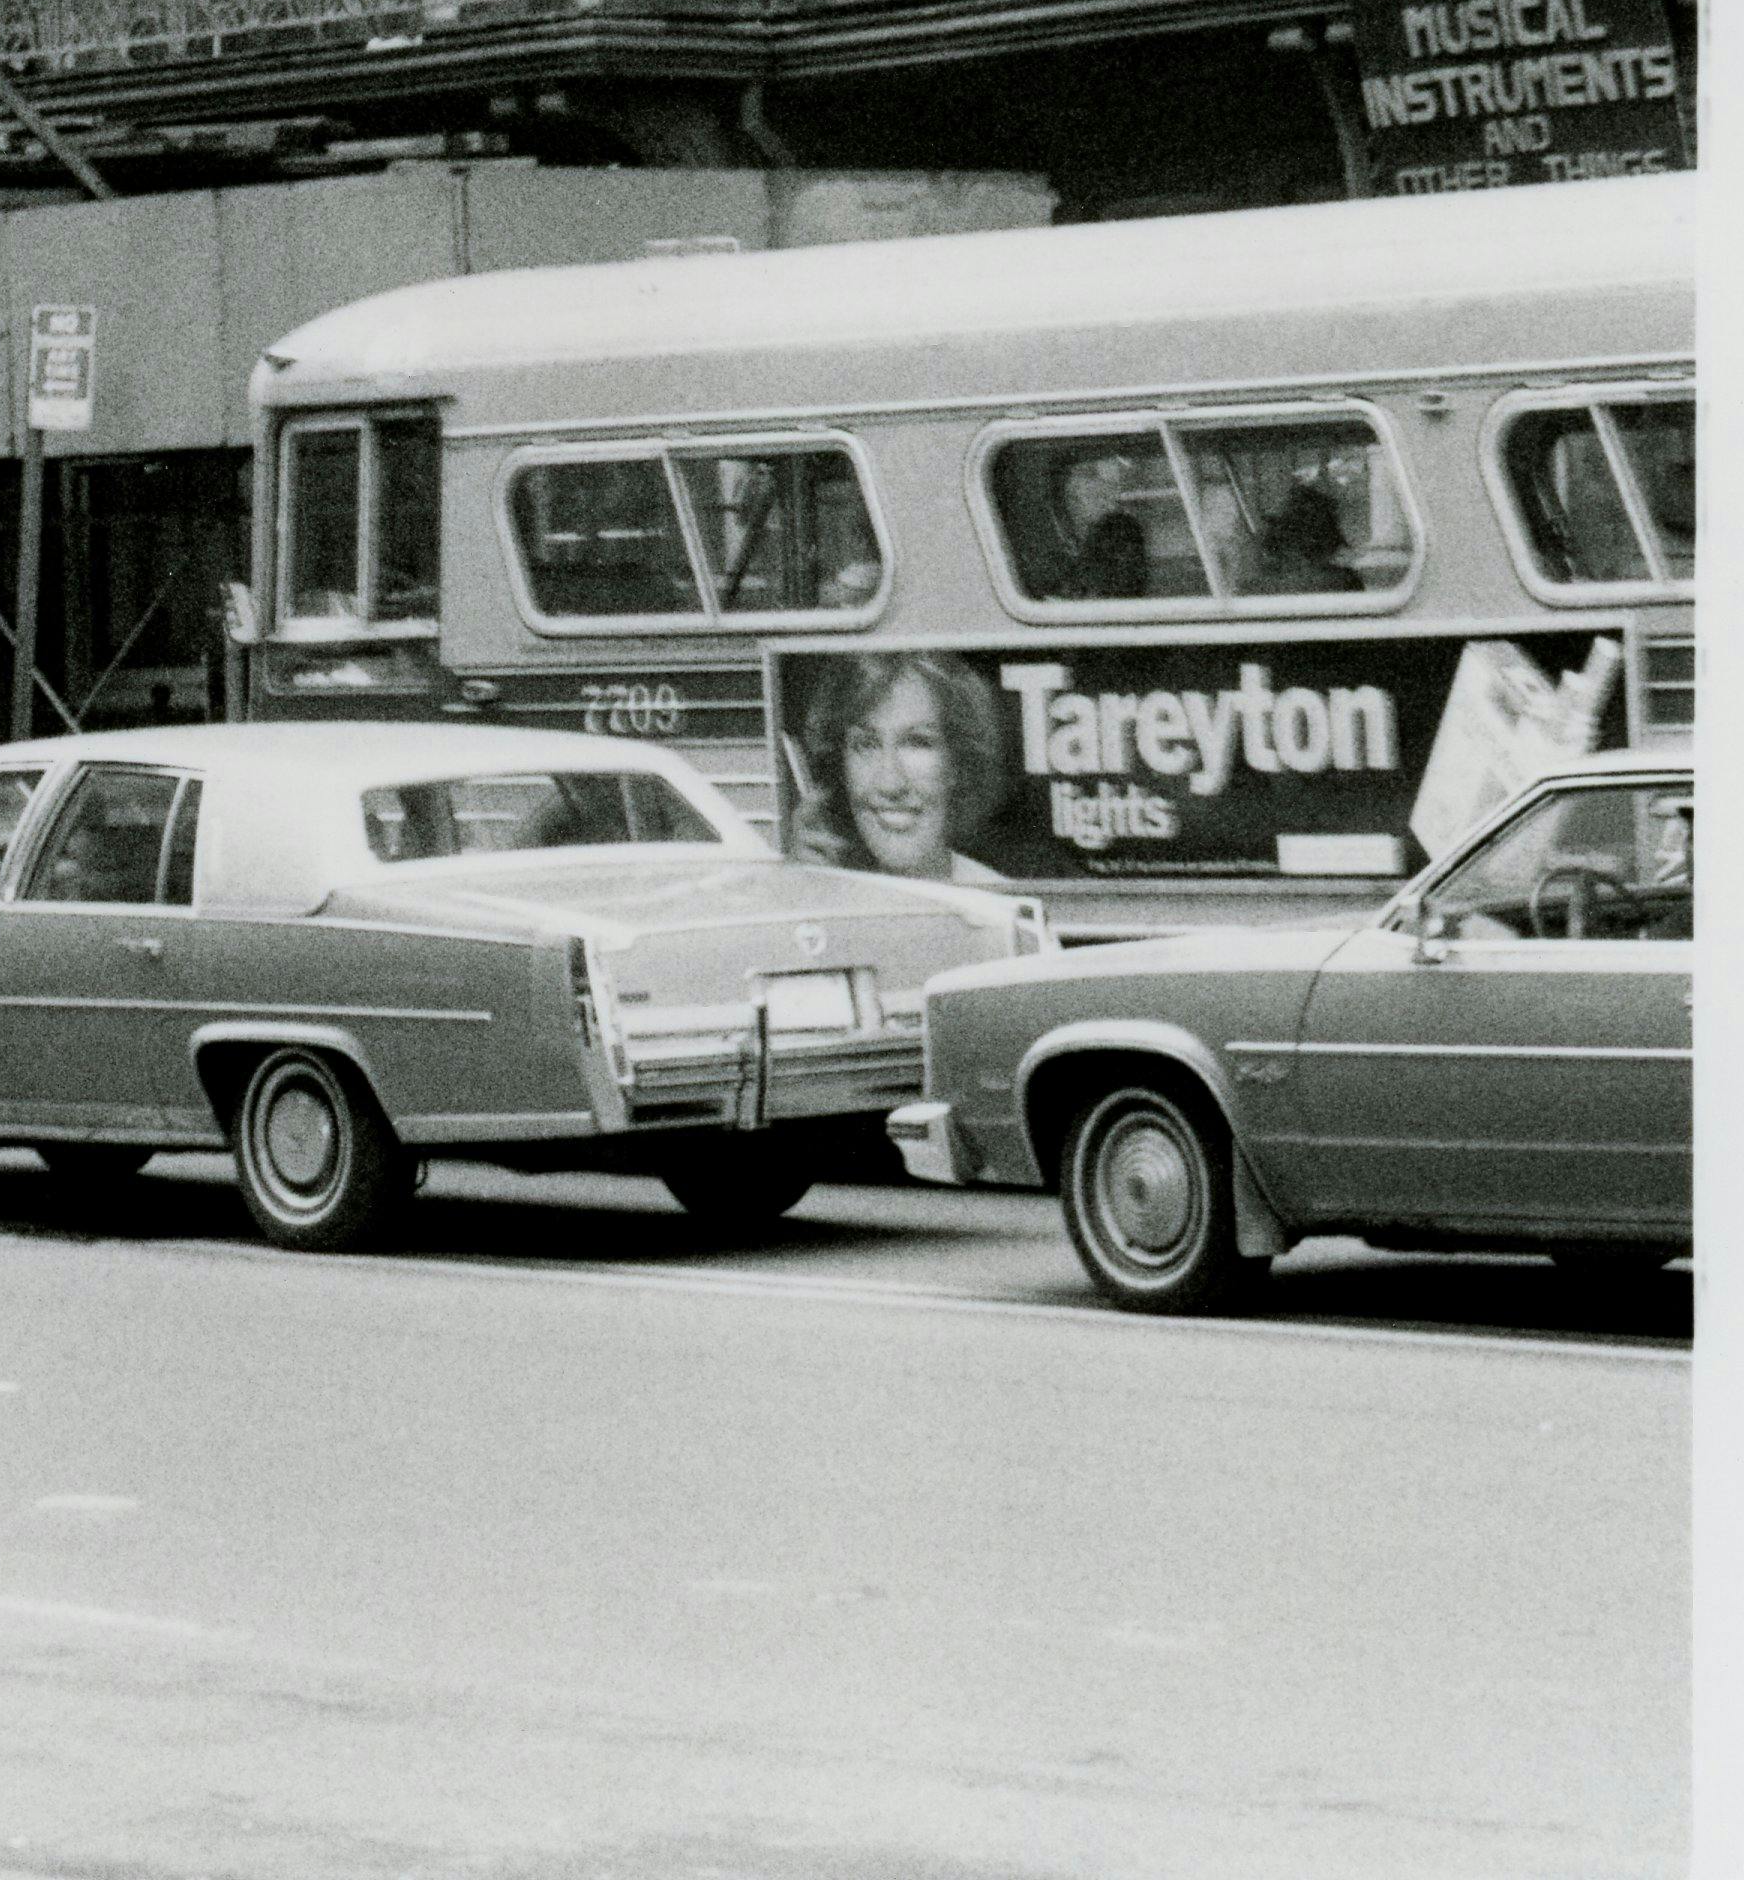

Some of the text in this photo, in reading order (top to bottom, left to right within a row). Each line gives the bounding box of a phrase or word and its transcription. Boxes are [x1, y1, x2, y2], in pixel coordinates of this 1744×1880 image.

[1361, 45, 1676, 131] INSTRUMENTS
[1484, 113, 1552, 157] AND
[581, 683, 678, 733] 7709
[1000, 663, 1399, 796] Tareyton
[1051, 781, 1180, 850] lights
